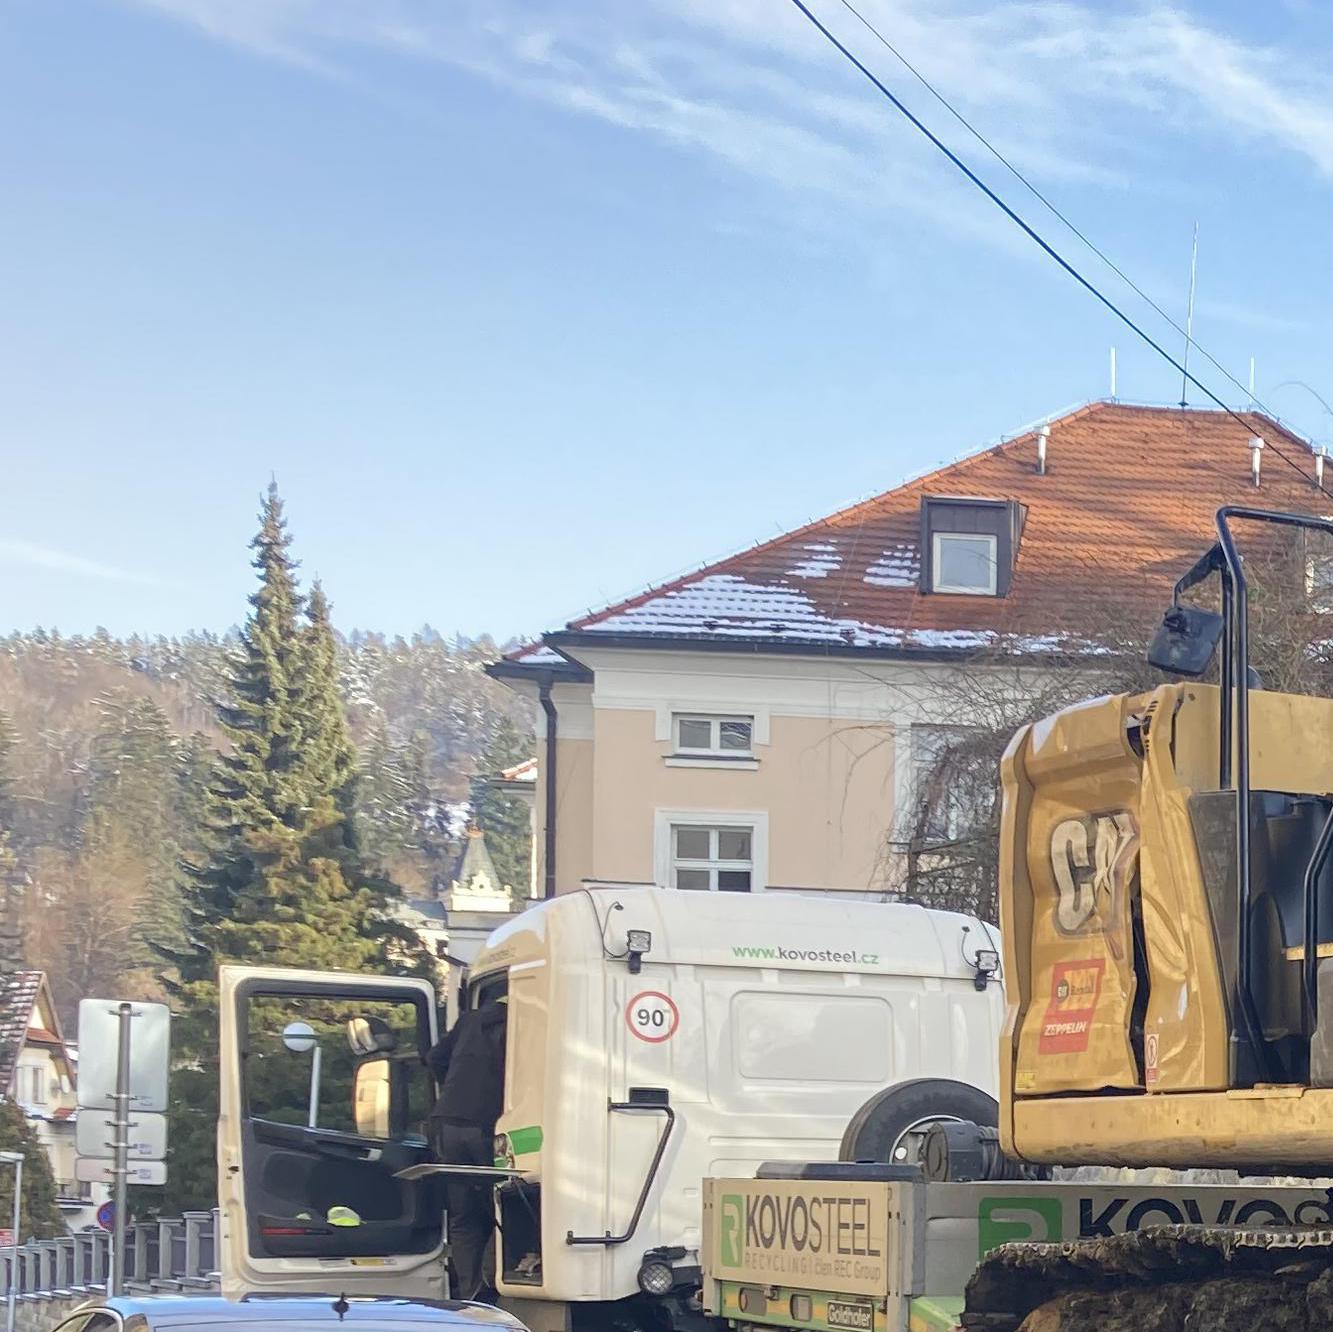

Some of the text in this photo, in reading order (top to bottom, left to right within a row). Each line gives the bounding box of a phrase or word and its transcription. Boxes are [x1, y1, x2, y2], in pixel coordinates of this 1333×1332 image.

[732, 946, 880, 965] www.kovosteel.cz
[637, 1008, 665, 1027] 90
[1043, 1020, 1088, 1037] ZEPPELIN
[745, 1194, 881, 1258] KOVOSTEEL
[744, 1252, 809, 1275] RECYCLING
[834, 1259, 852, 1279] REC
[854, 1261, 881, 1283] Group
[828, 1303, 871, 1327] Goldhofer
